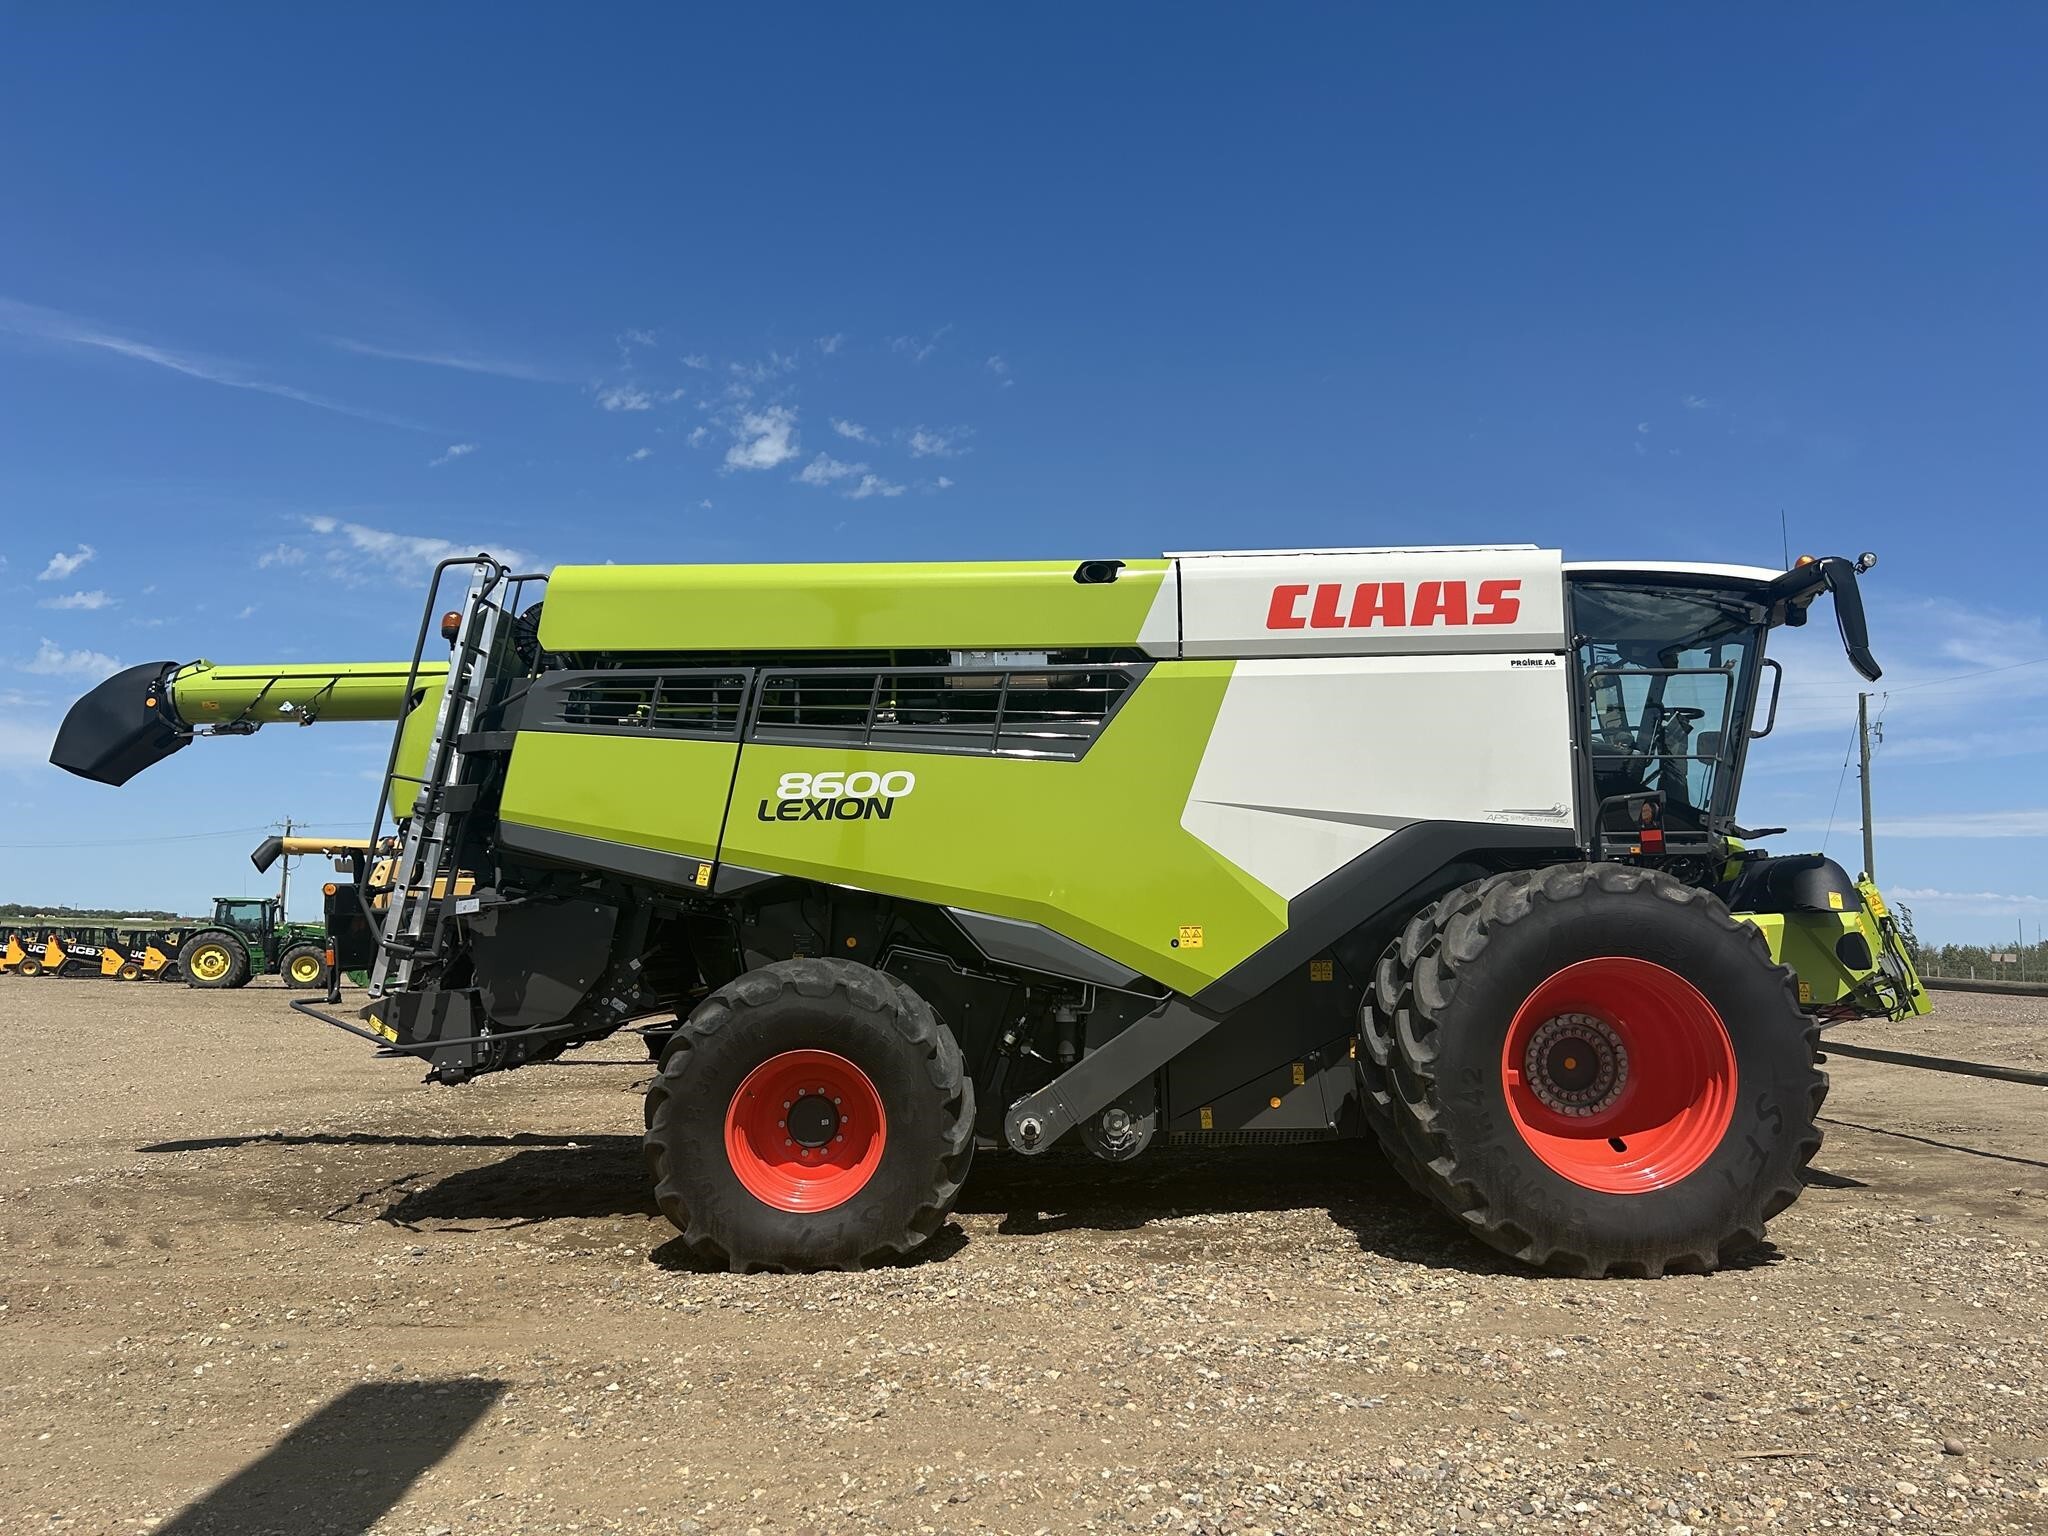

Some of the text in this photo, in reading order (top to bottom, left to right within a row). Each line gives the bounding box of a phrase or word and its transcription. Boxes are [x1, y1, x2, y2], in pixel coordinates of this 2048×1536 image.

[1266, 580, 1522, 629] CLAAS
[776, 770, 916, 800] 8600
[757, 797, 895, 822] LEXION
[1486, 814, 1509, 823] APS
[27, 944, 46, 954] JC
[67, 945, 95, 956] JCB
[130, 950, 146, 959] JC
